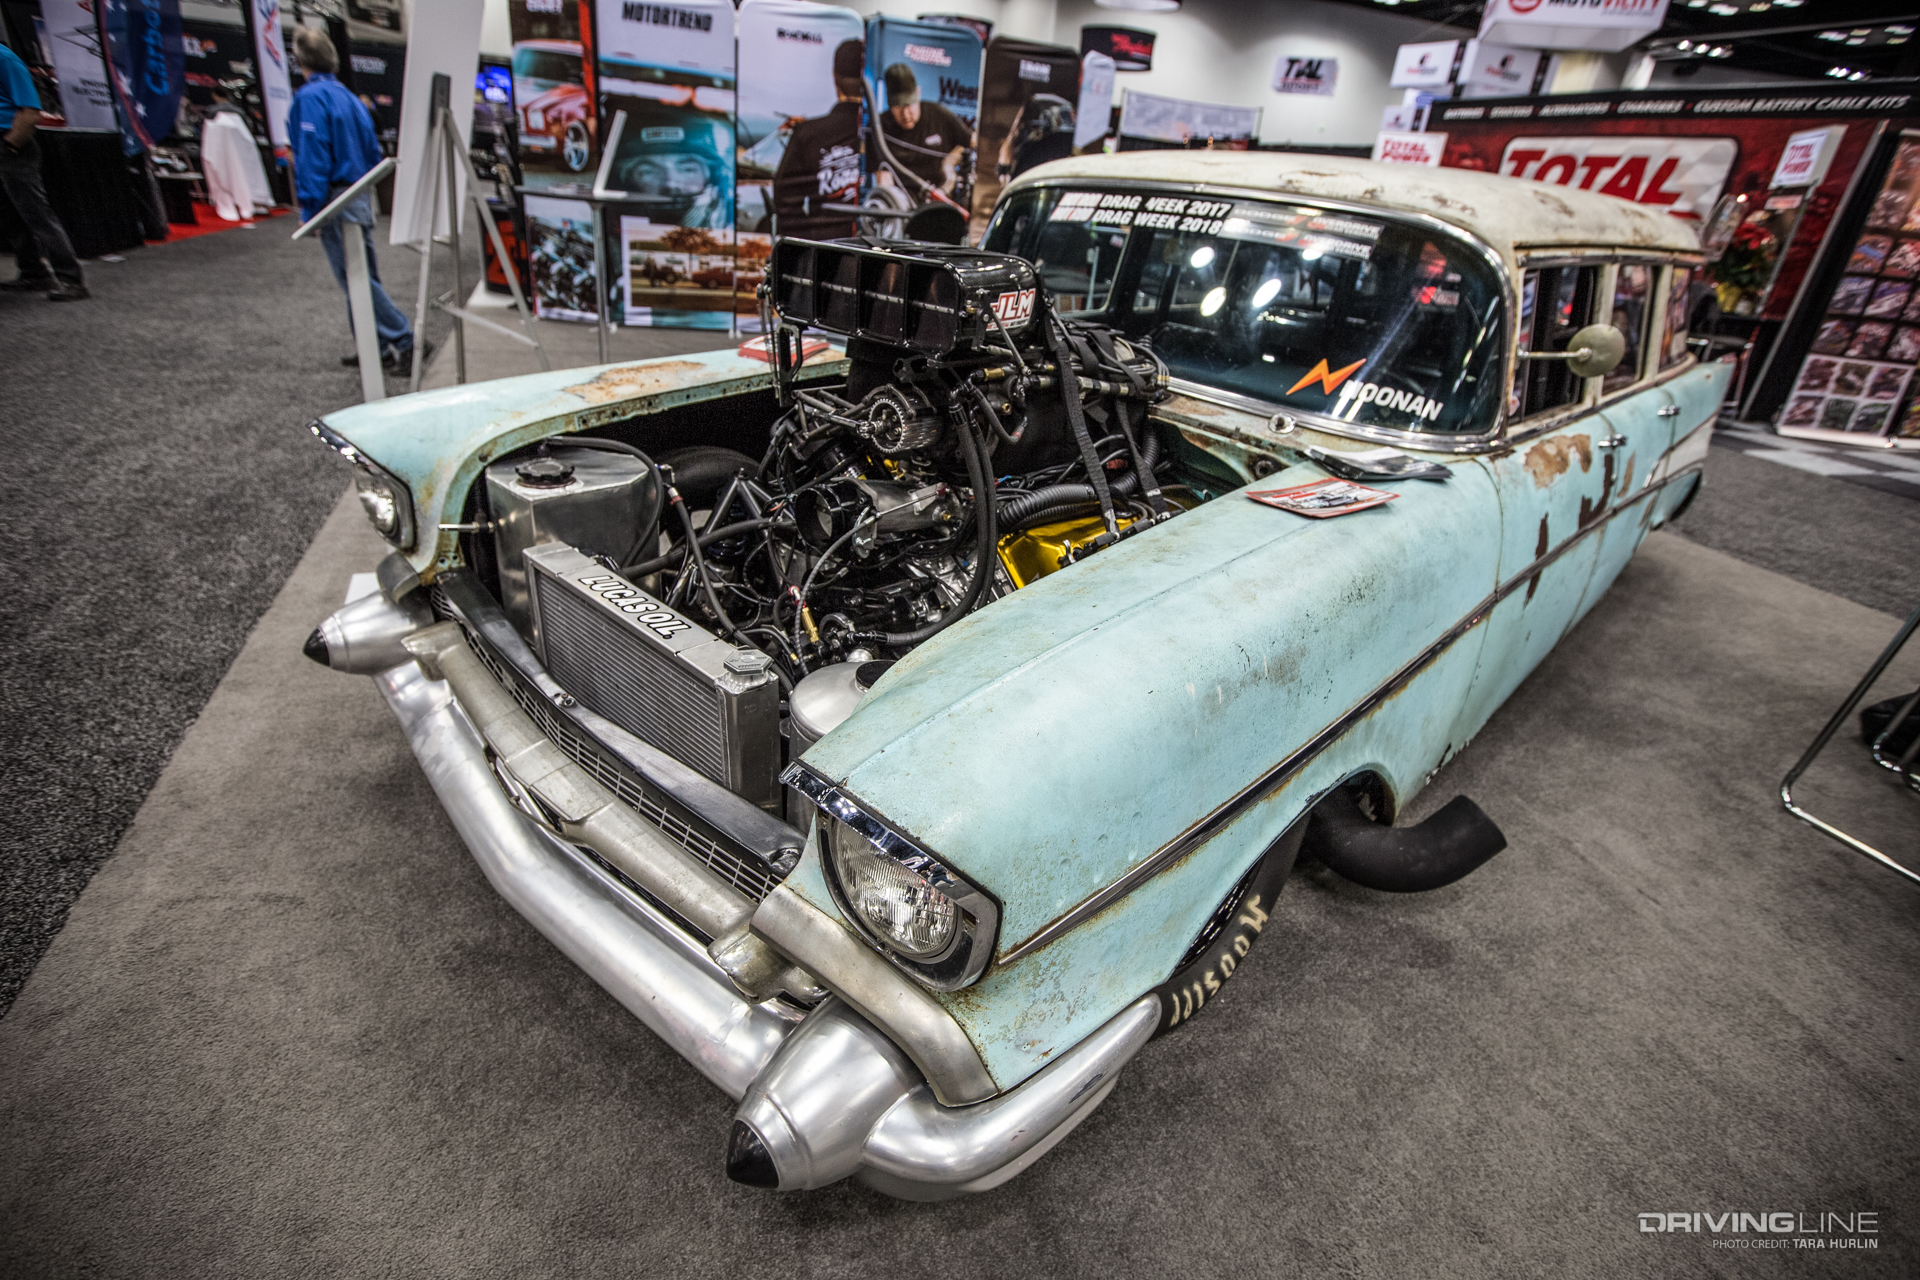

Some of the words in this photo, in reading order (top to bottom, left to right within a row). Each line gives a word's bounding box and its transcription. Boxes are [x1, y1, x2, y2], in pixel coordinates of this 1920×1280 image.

[621, 2, 713, 32] MOTORTREND
[1693, 99, 1753, 113] CUSTOM
[1751, 97, 1817, 112] BATTERY
[1815, 96, 1870, 110] CABLE
[1865, 94, 1911, 109] KITS
[1508, 149, 1682, 205] TOTAL
[1100, 194, 1142, 210] DRAG
[1187, 200, 1232, 218] 2017
[1234, 208, 1296, 222] DODGE
[1092, 209, 1134, 225] DRAG
[1134, 212, 1181, 230] WEEK
[1178, 216, 1224, 235] 2018
[1313, 216, 1381, 234] OVERDRIVE
[989, 288, 1036, 321] JLM
[1339, 379, 1444, 421] NOONAN
[578, 574, 660, 613] LUCAS
[637, 612, 692, 638] OIL
